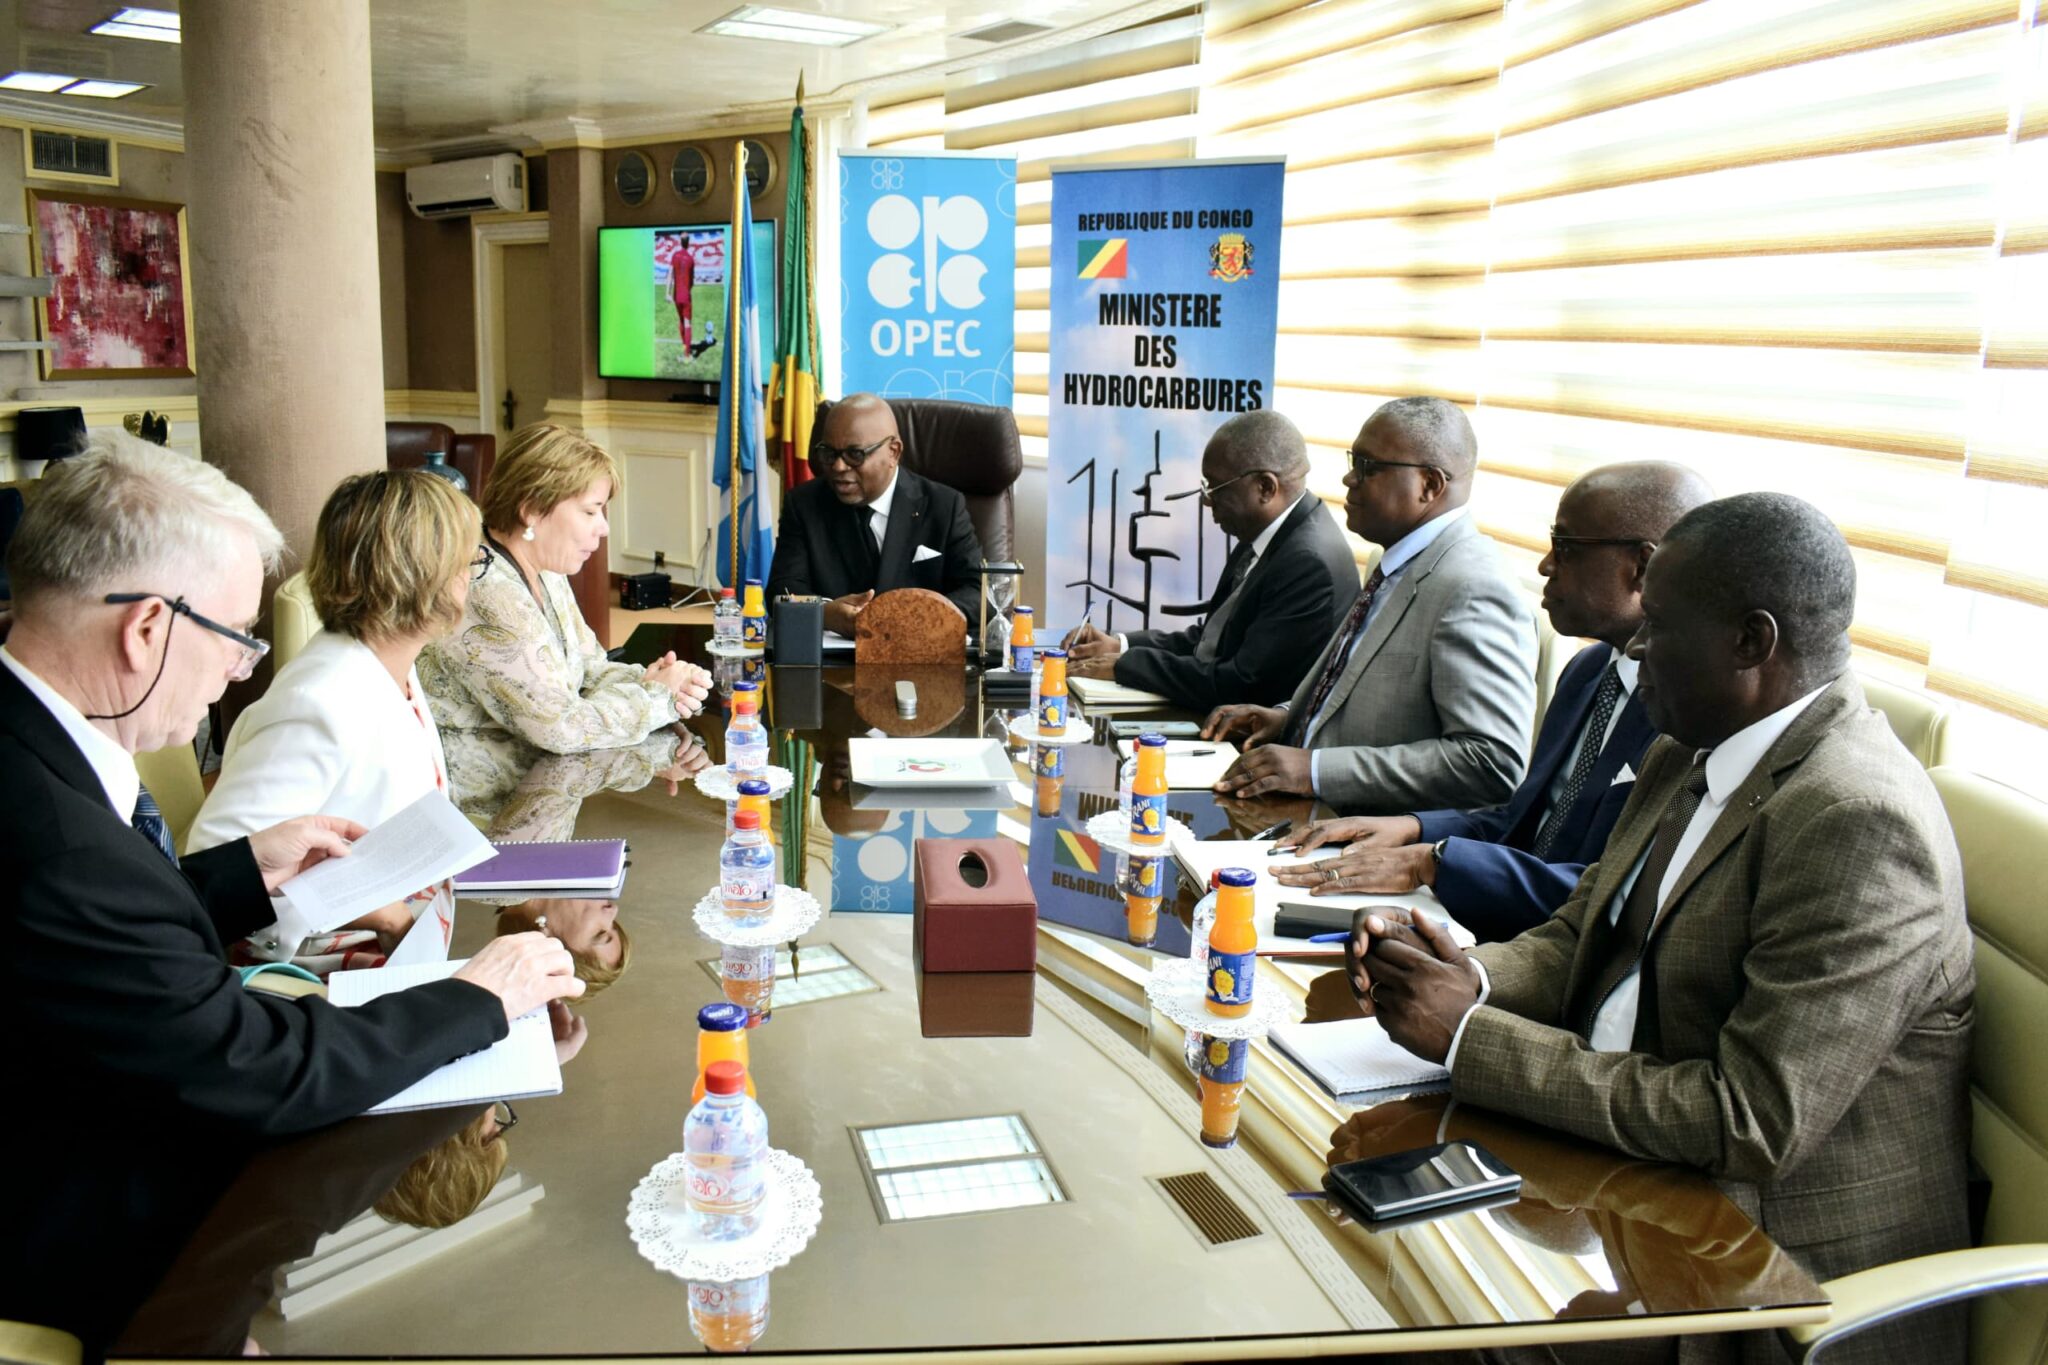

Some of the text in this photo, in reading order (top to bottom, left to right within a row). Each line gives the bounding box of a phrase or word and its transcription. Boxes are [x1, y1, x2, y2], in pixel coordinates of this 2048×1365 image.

[1078, 209, 1253, 232] REPUBLIQUE DU CONGO
[1099, 293, 1221, 328] MINISTERE
[870, 318, 981, 358] OPEC
[1134, 335, 1177, 368] DES
[1064, 373, 1262, 412] HYDROCARBURES
